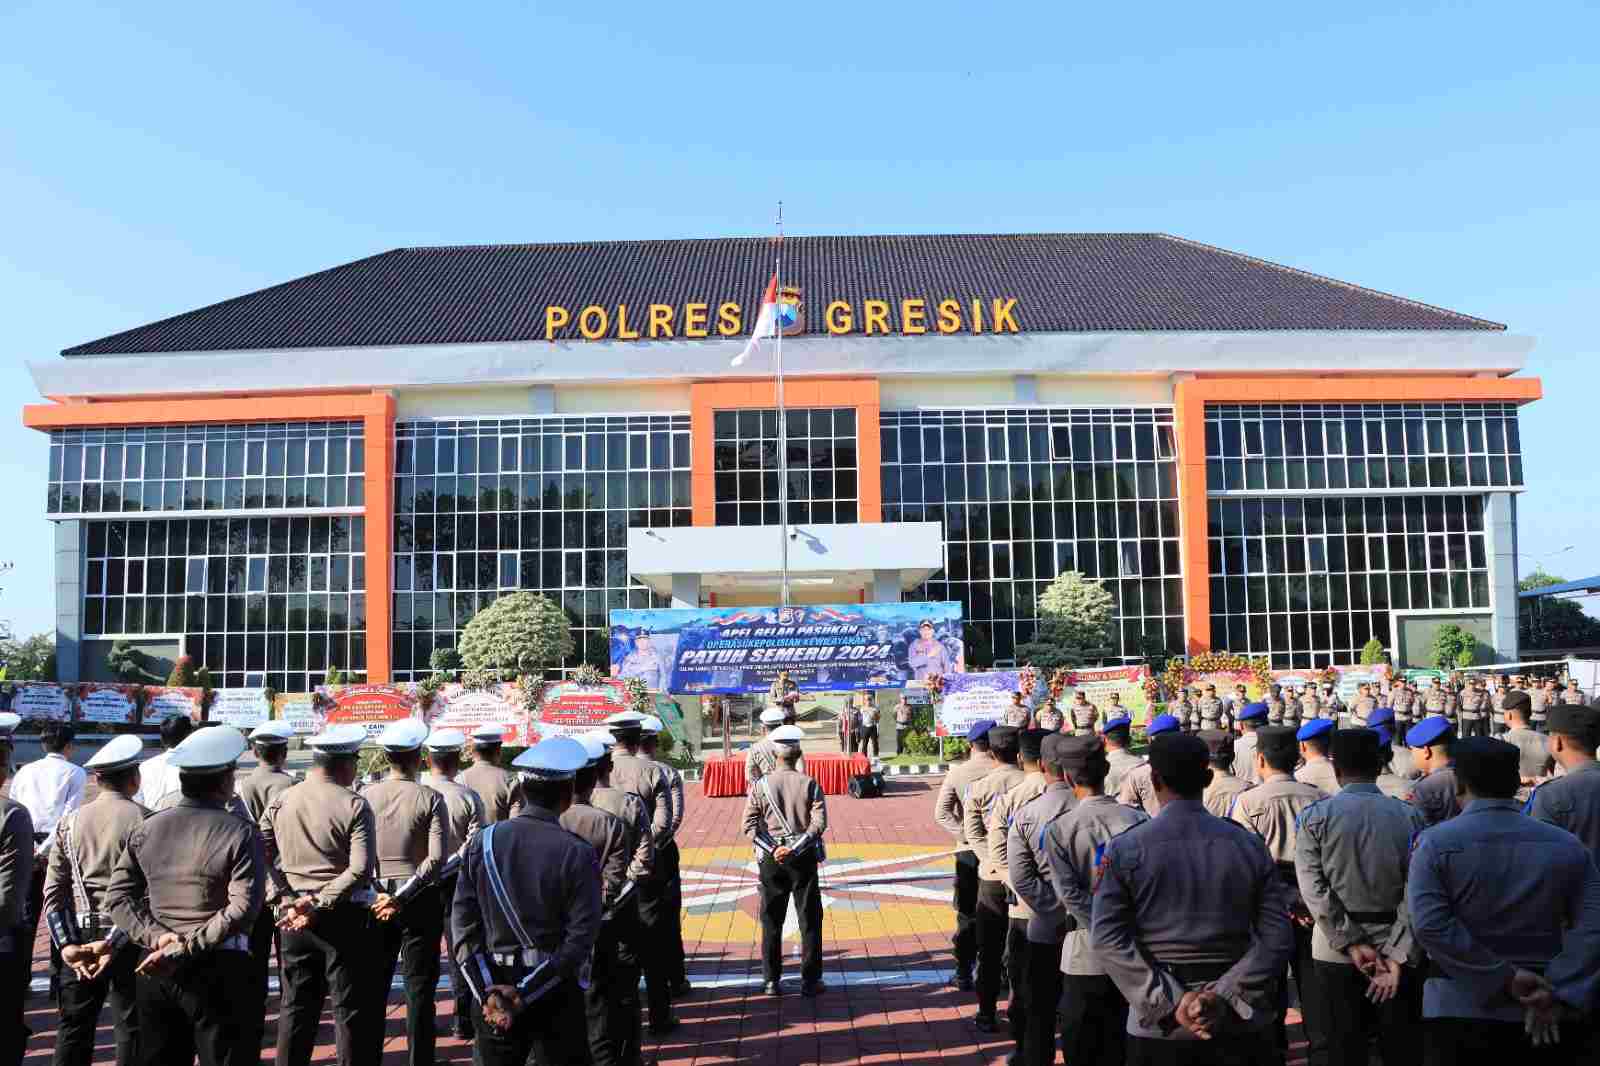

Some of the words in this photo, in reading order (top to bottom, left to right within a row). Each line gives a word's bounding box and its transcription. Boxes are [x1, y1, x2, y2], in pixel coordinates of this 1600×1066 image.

[544, 302, 742, 339] POLRES
[825, 298, 1020, 335] GRESIK
[721, 628, 751, 638] APEL
[754, 627, 795, 637] GELAR
[797, 625, 858, 635] PASUKAN
[679, 649, 748, 664] PATUH
[749, 646, 835, 662] SEMERU
[835, 644, 892, 660] 2024
